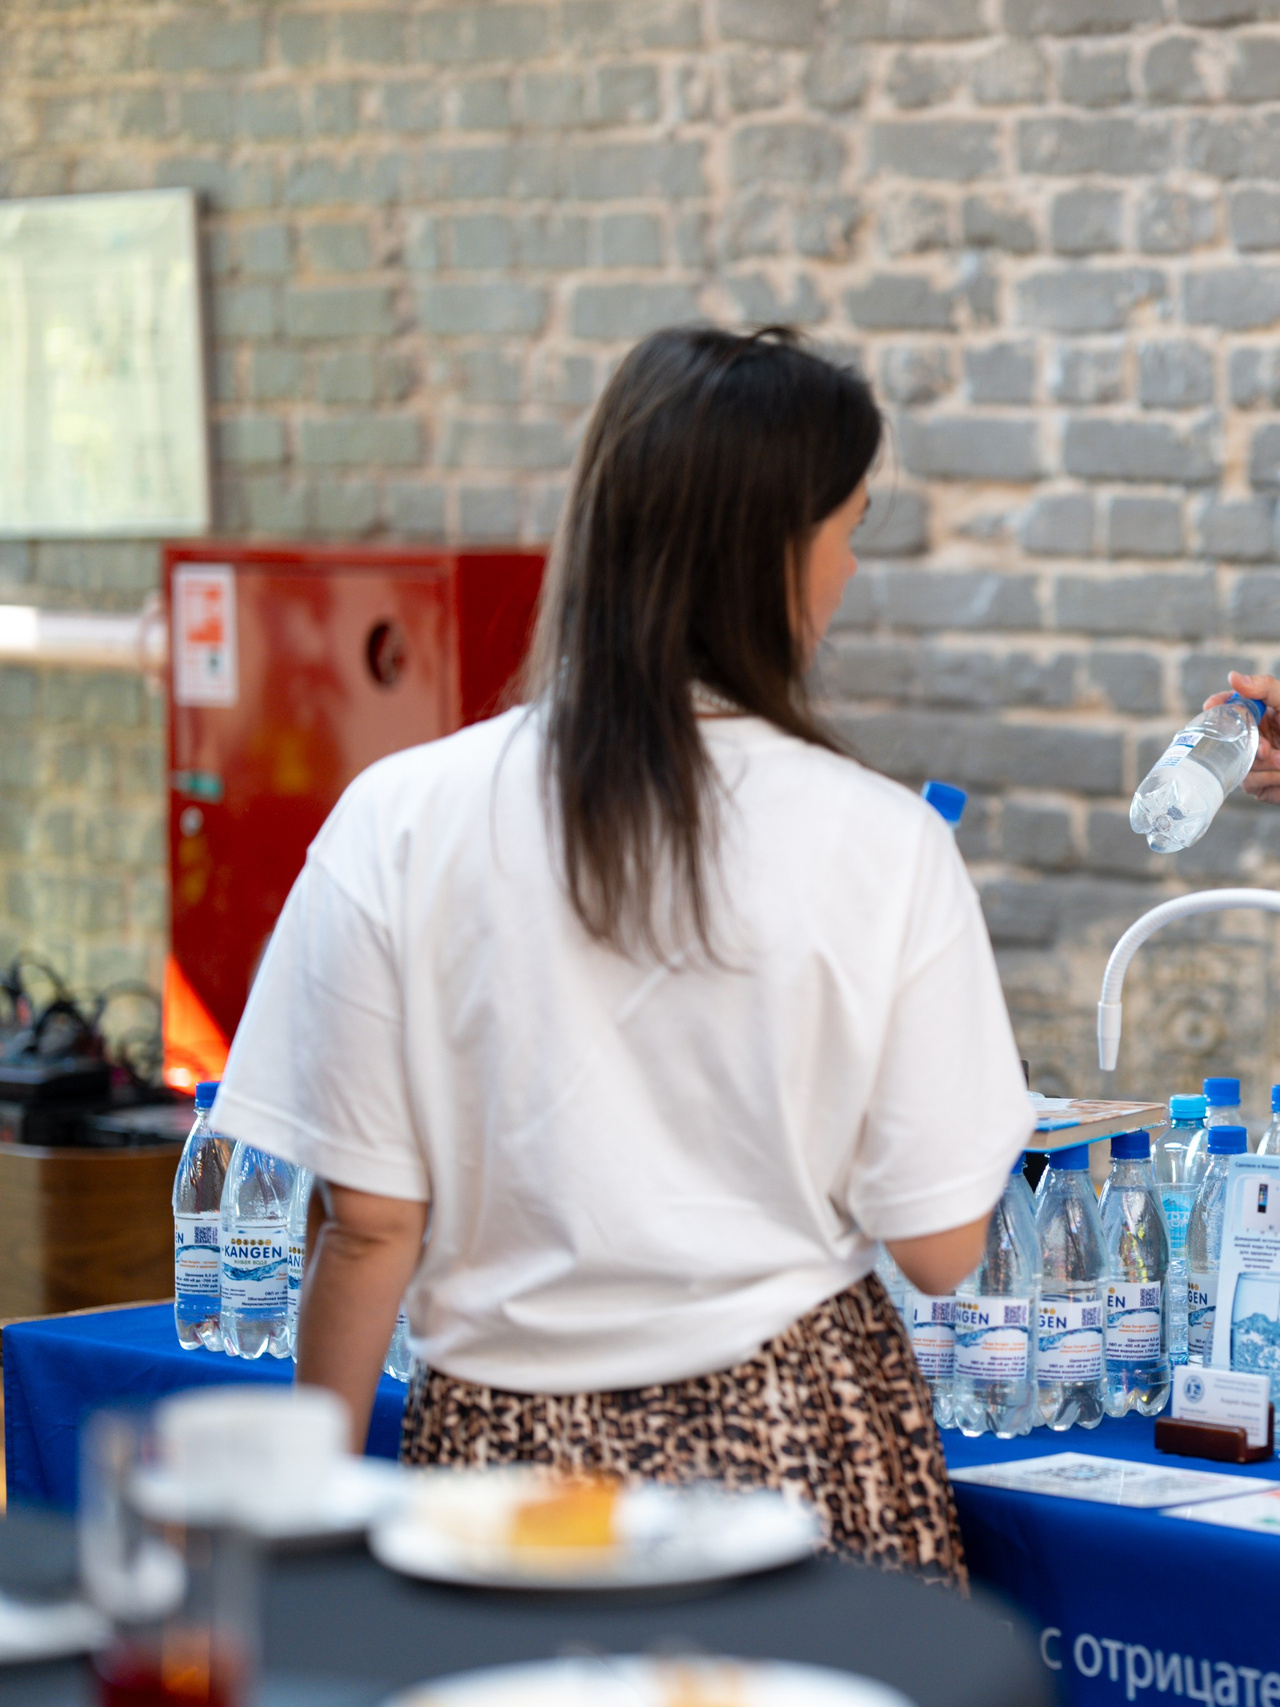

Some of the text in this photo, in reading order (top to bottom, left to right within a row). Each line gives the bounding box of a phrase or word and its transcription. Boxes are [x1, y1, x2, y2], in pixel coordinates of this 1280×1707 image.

[225, 1246, 282, 1258] KANGEN
[1188, 1290, 1208, 1305] GEN
[956, 1310, 989, 1325] NGEN
[1039, 1315, 1067, 1329] GEN
